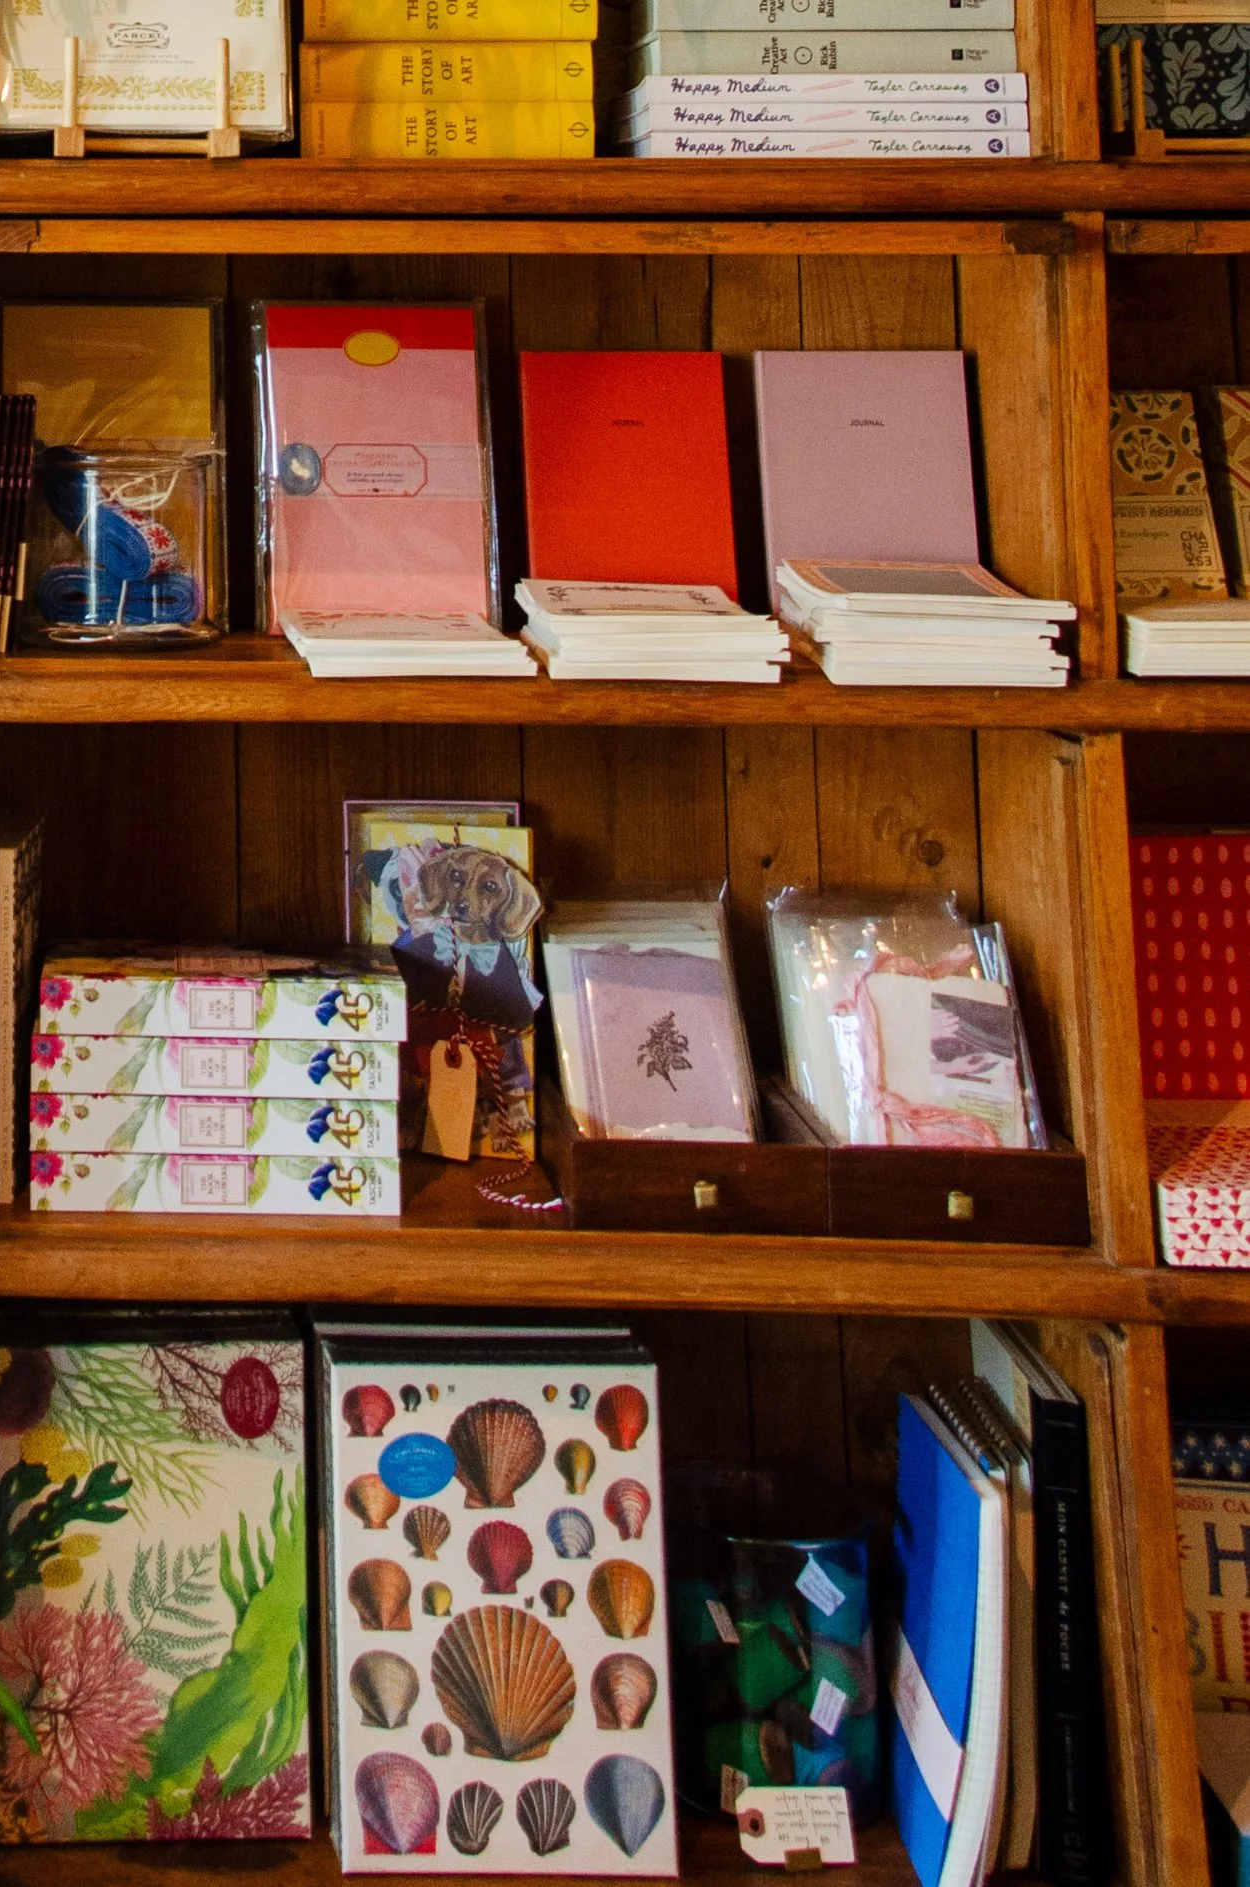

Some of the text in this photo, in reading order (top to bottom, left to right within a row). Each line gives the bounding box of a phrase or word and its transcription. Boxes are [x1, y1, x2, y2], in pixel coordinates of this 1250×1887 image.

[114, 32, 165, 40] PARCEL
[762, 46, 770, 65] The
[770, 36, 779, 74] Creative
[779, 48, 788, 64] Act
[820, 46, 828, 66] Rick
[828, 40, 837, 70] Rubin
[402, 55, 414, 86] THE
[422, 48, 434, 95] STORY
[441, 60, 453, 80] OF
[461, 56, 473, 85] ART
[671, 77, 792, 96] Happy Medium
[909, 80, 969, 92] Carraway
[674, 106, 794, 125] Happy Medium
[910, 110, 970, 124] Carraway
[406, 116, 418, 147] THE
[426, 108, 438, 156] STORY
[446, 121, 458, 142] OF
[466, 116, 478, 146] ART
[675, 136, 796, 155] Happy Medium
[912, 140, 972, 153] Carraway
[612, 418, 646, 426] JOURNAL
[850, 419, 885, 427] JOURNAL
[340, 986, 374, 1032] 45
[332, 1044, 366, 1090] 45
[368, 1051, 376, 1090] TASCHEN
[331, 1105, 365, 1149] 45
[333, 1162, 367, 1206] 45
[368, 1167, 376, 1206] TASCHEN
[1057, 1502, 1071, 1670] MON CARNET de POCHE
